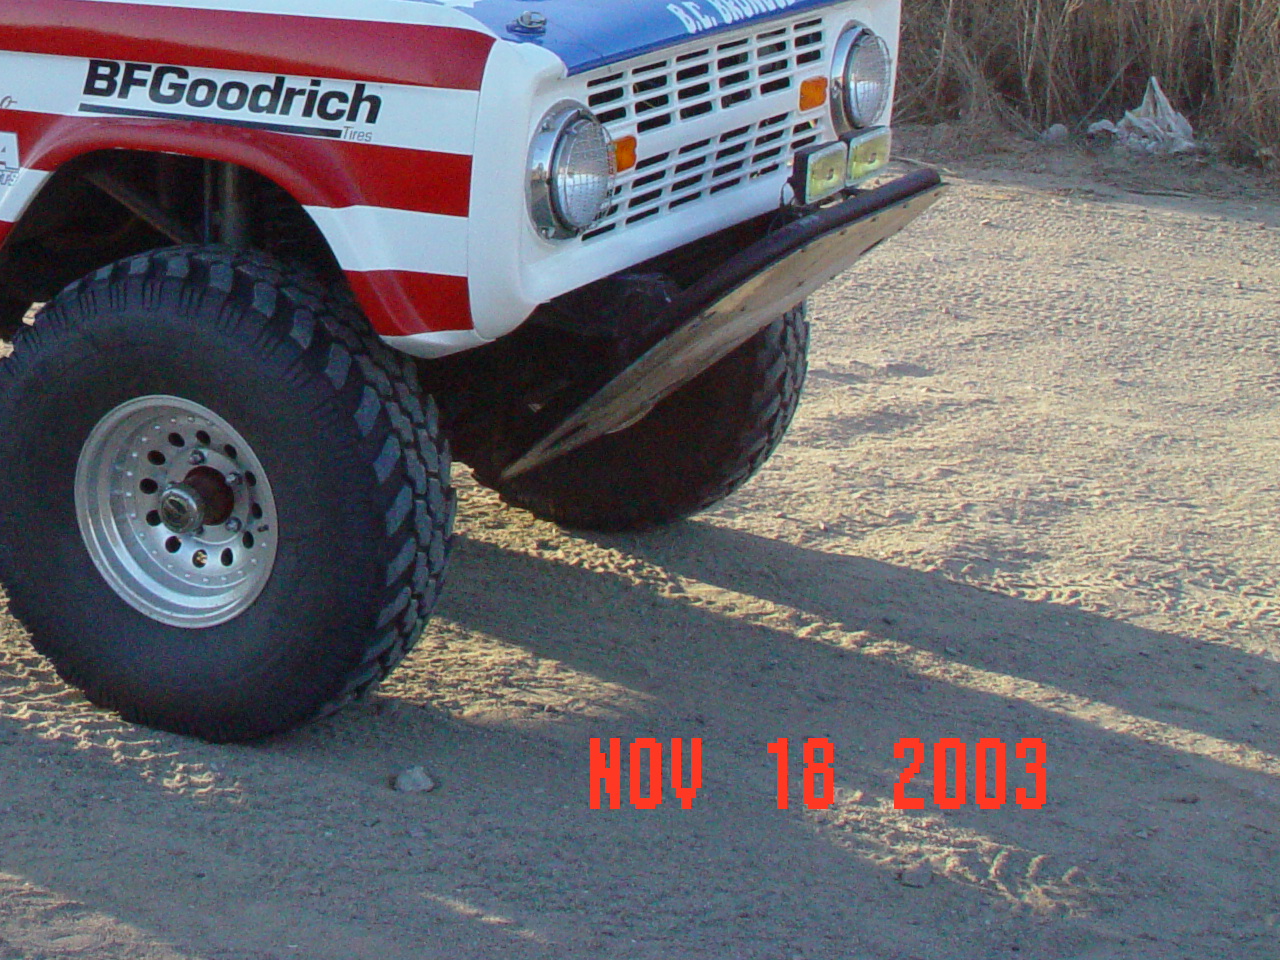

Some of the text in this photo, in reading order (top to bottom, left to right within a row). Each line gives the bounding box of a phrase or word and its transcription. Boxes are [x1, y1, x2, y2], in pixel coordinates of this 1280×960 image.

[666, 1, 718, 34] B.C.
[82, 59, 382, 124] BFGoodrich
[341, 126, 373, 142] Tires
